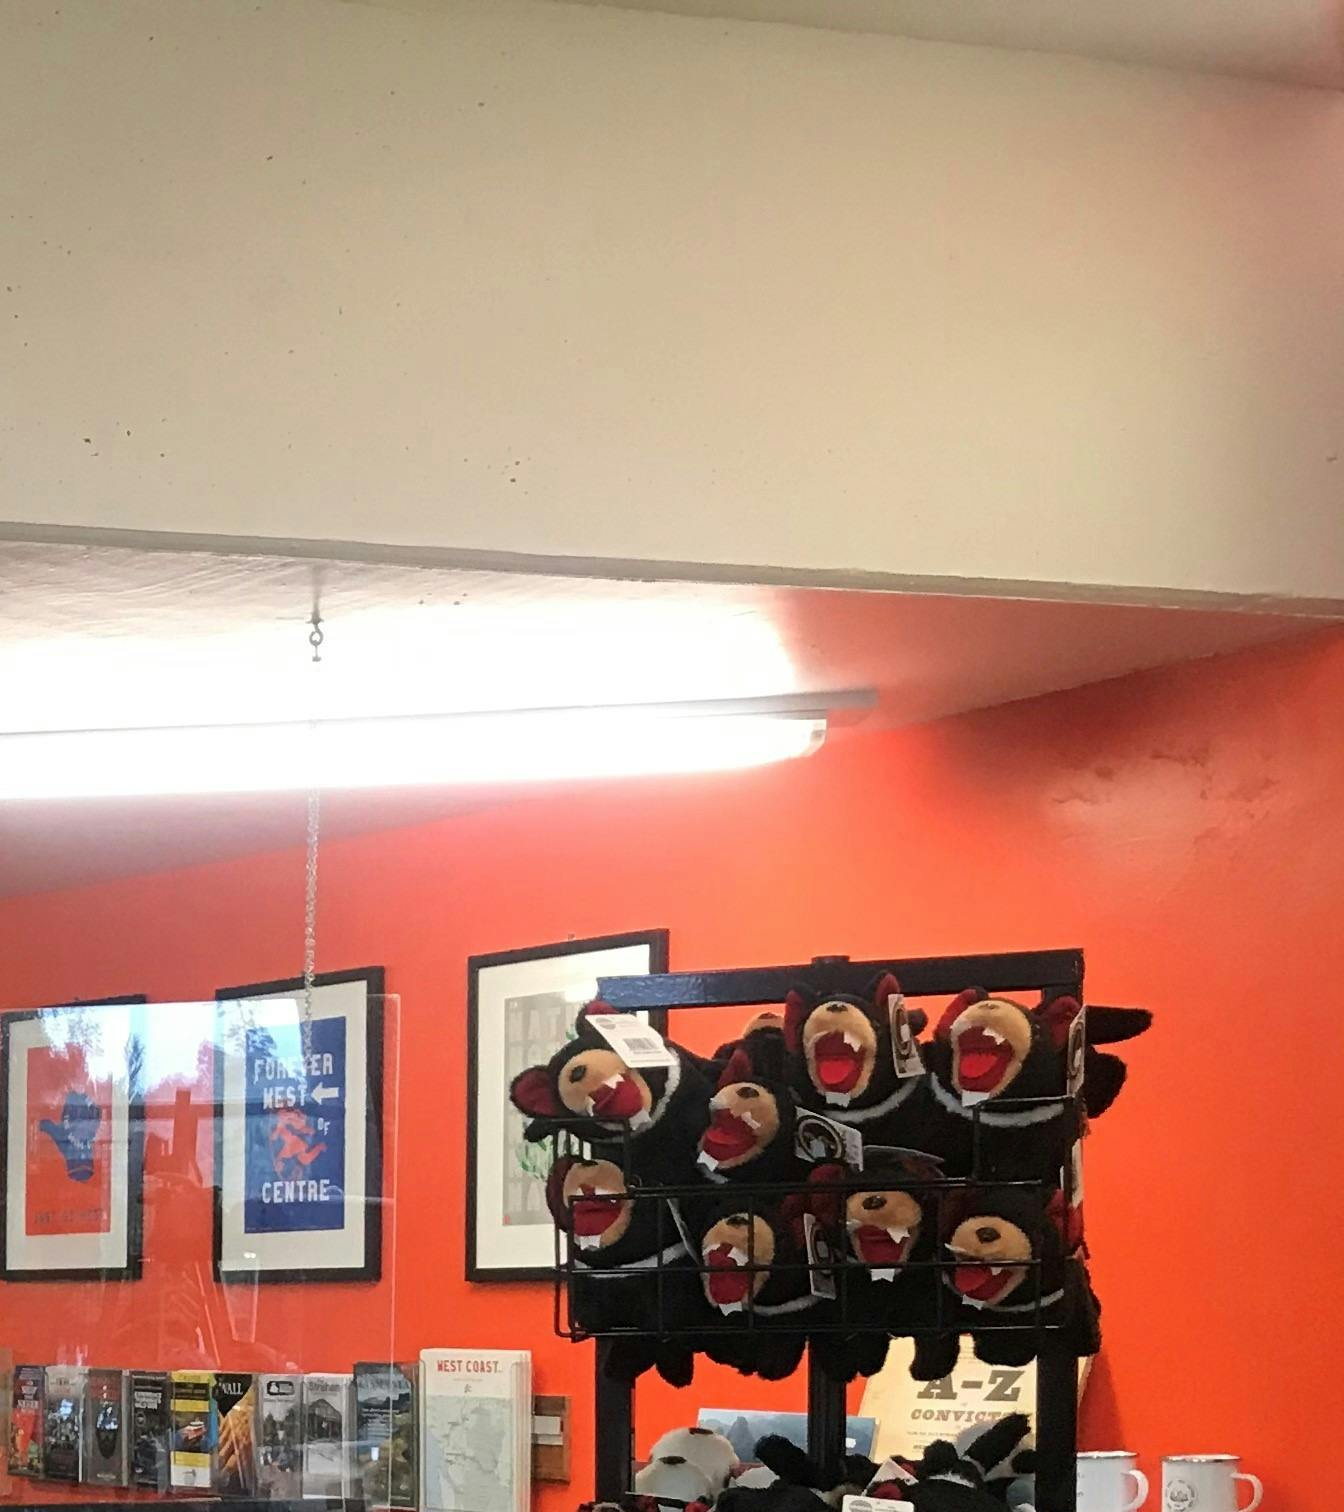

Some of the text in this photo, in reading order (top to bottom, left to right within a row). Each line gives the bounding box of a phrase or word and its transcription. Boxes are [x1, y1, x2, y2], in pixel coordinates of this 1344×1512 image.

[263, 1084, 308, 1110] WEST
[317, 1117, 330, 1136] OF
[262, 1178, 331, 1204] CENTRE
[436, 1360, 500, 1374] WEST COAST
[917, 1369, 1026, 1402] A-Z
[910, 1409, 1009, 1423] CONVICT
